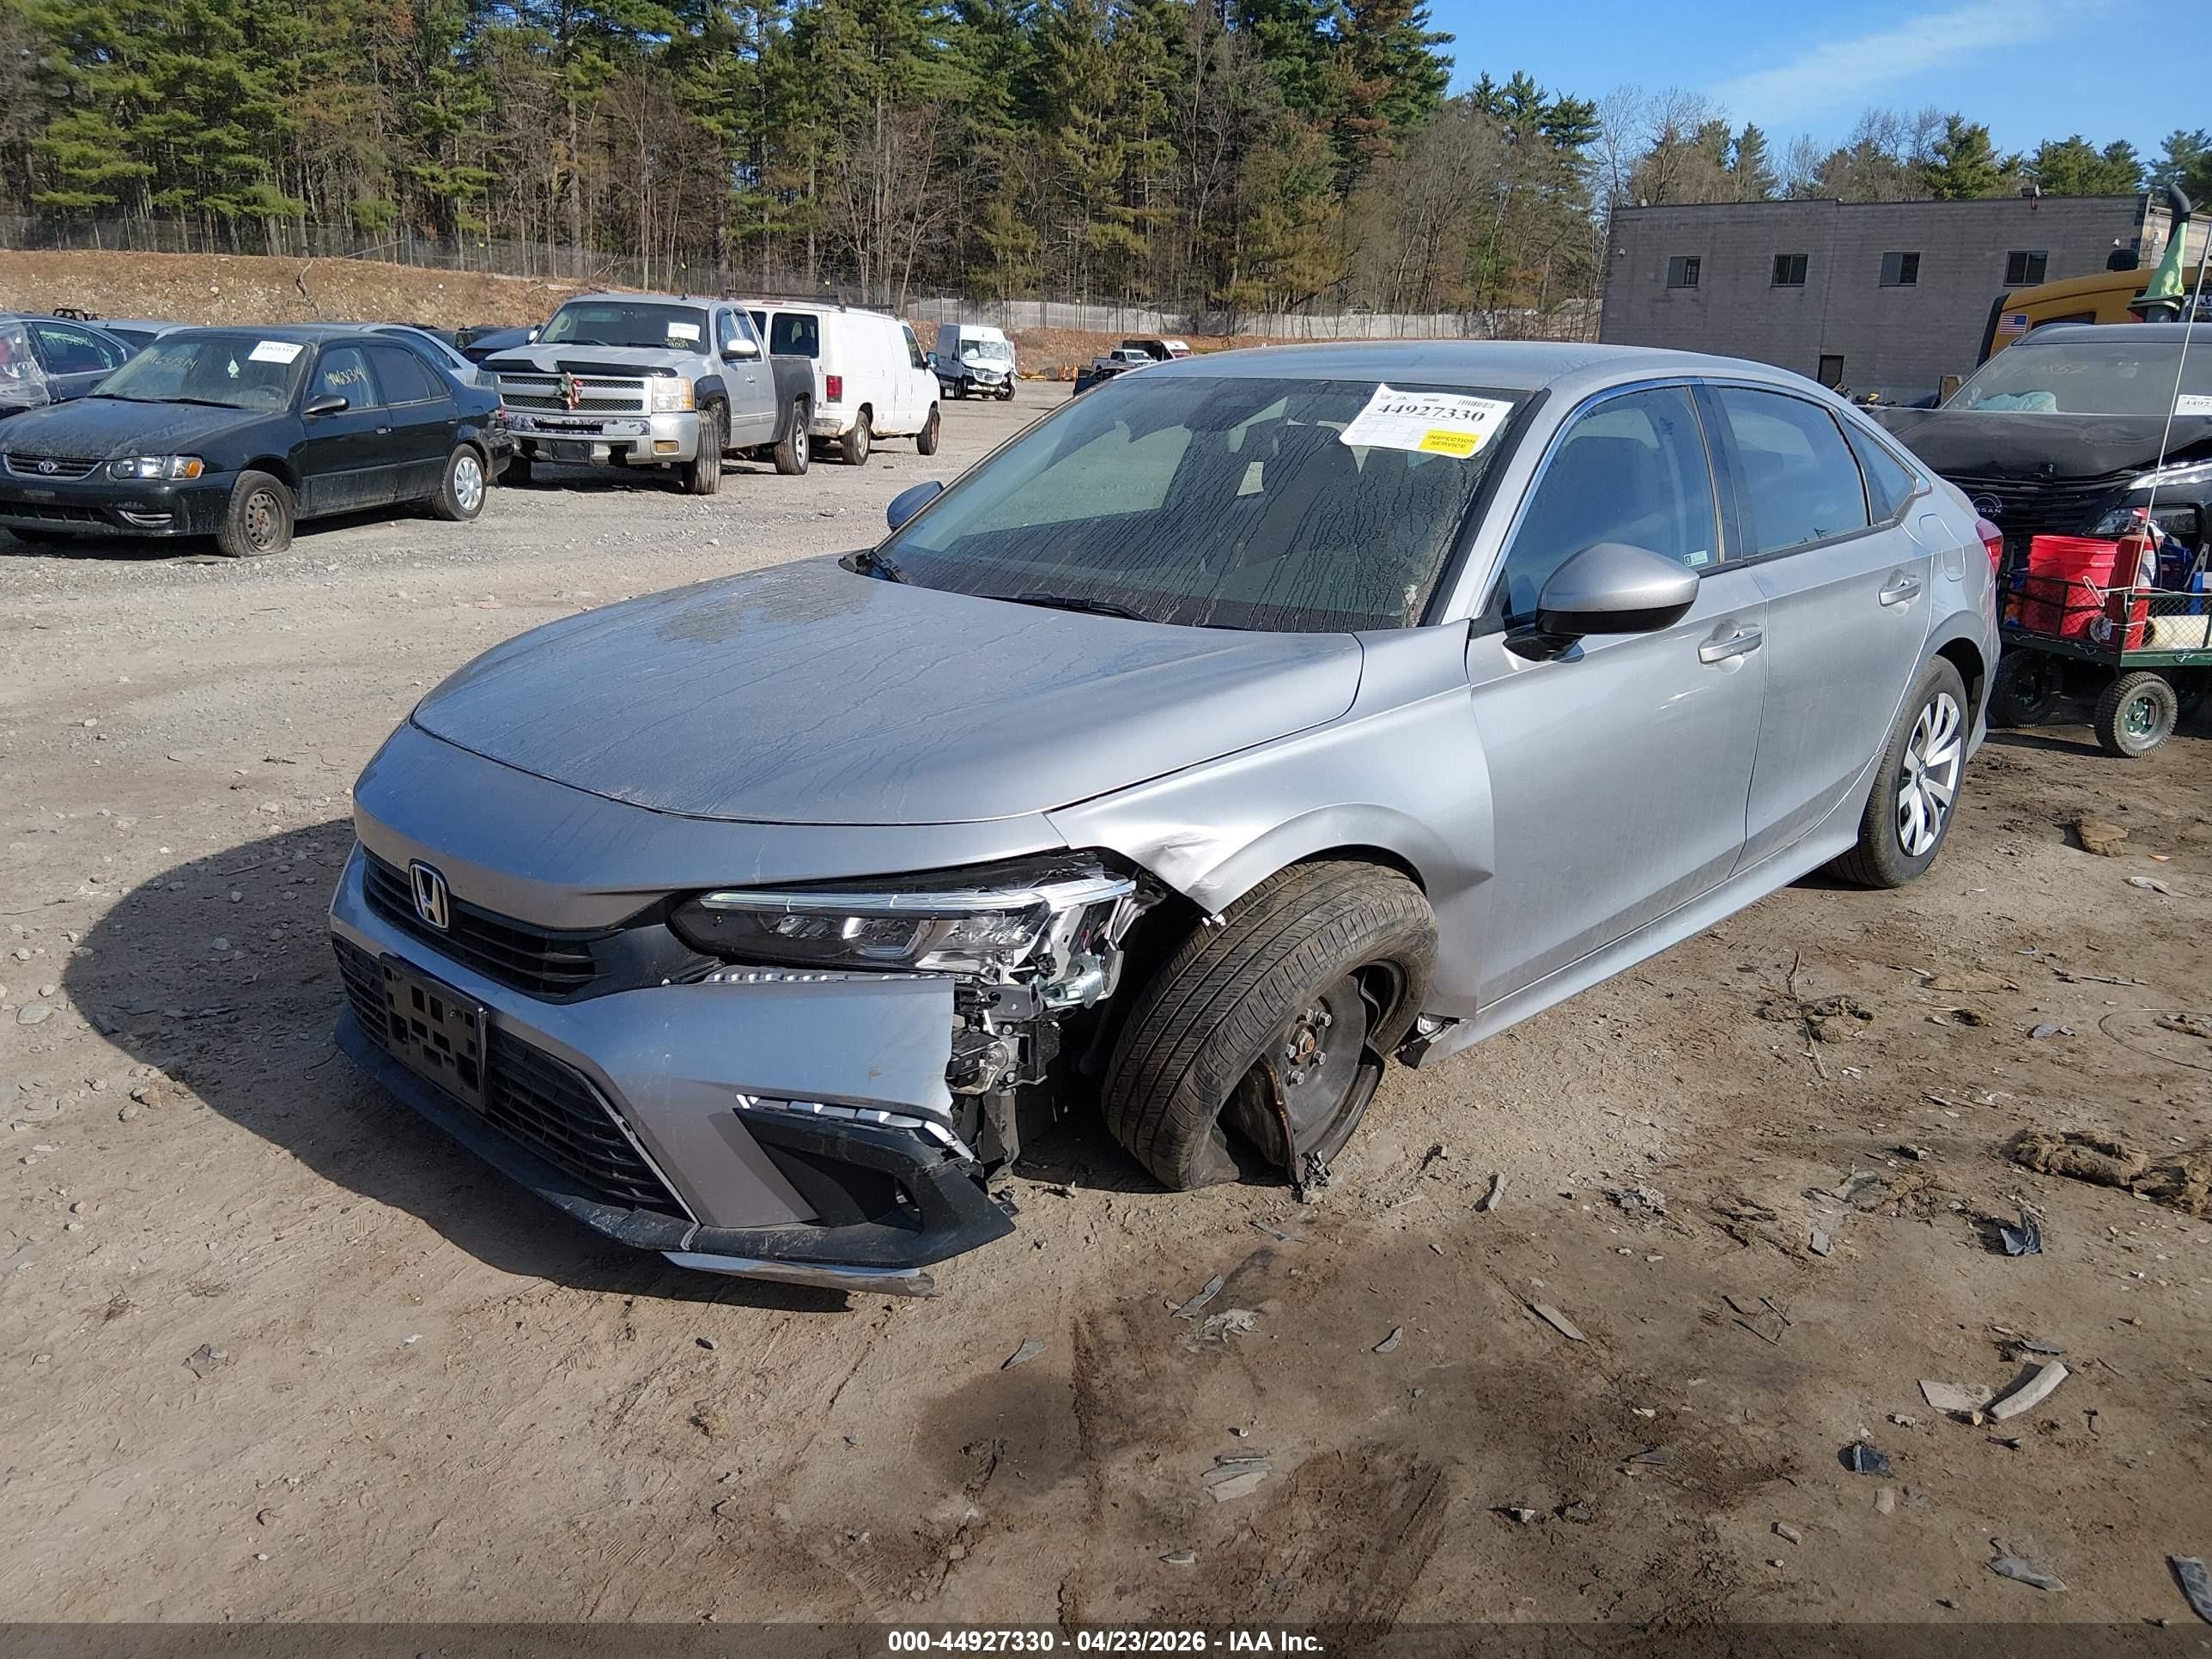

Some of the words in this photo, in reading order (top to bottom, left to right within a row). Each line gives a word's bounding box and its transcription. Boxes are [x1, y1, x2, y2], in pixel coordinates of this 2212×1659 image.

[1377, 403, 1486, 422] 44927330
[1427, 434, 1476, 445] INSPECTION
[1430, 441, 1467, 449] SERVICE
